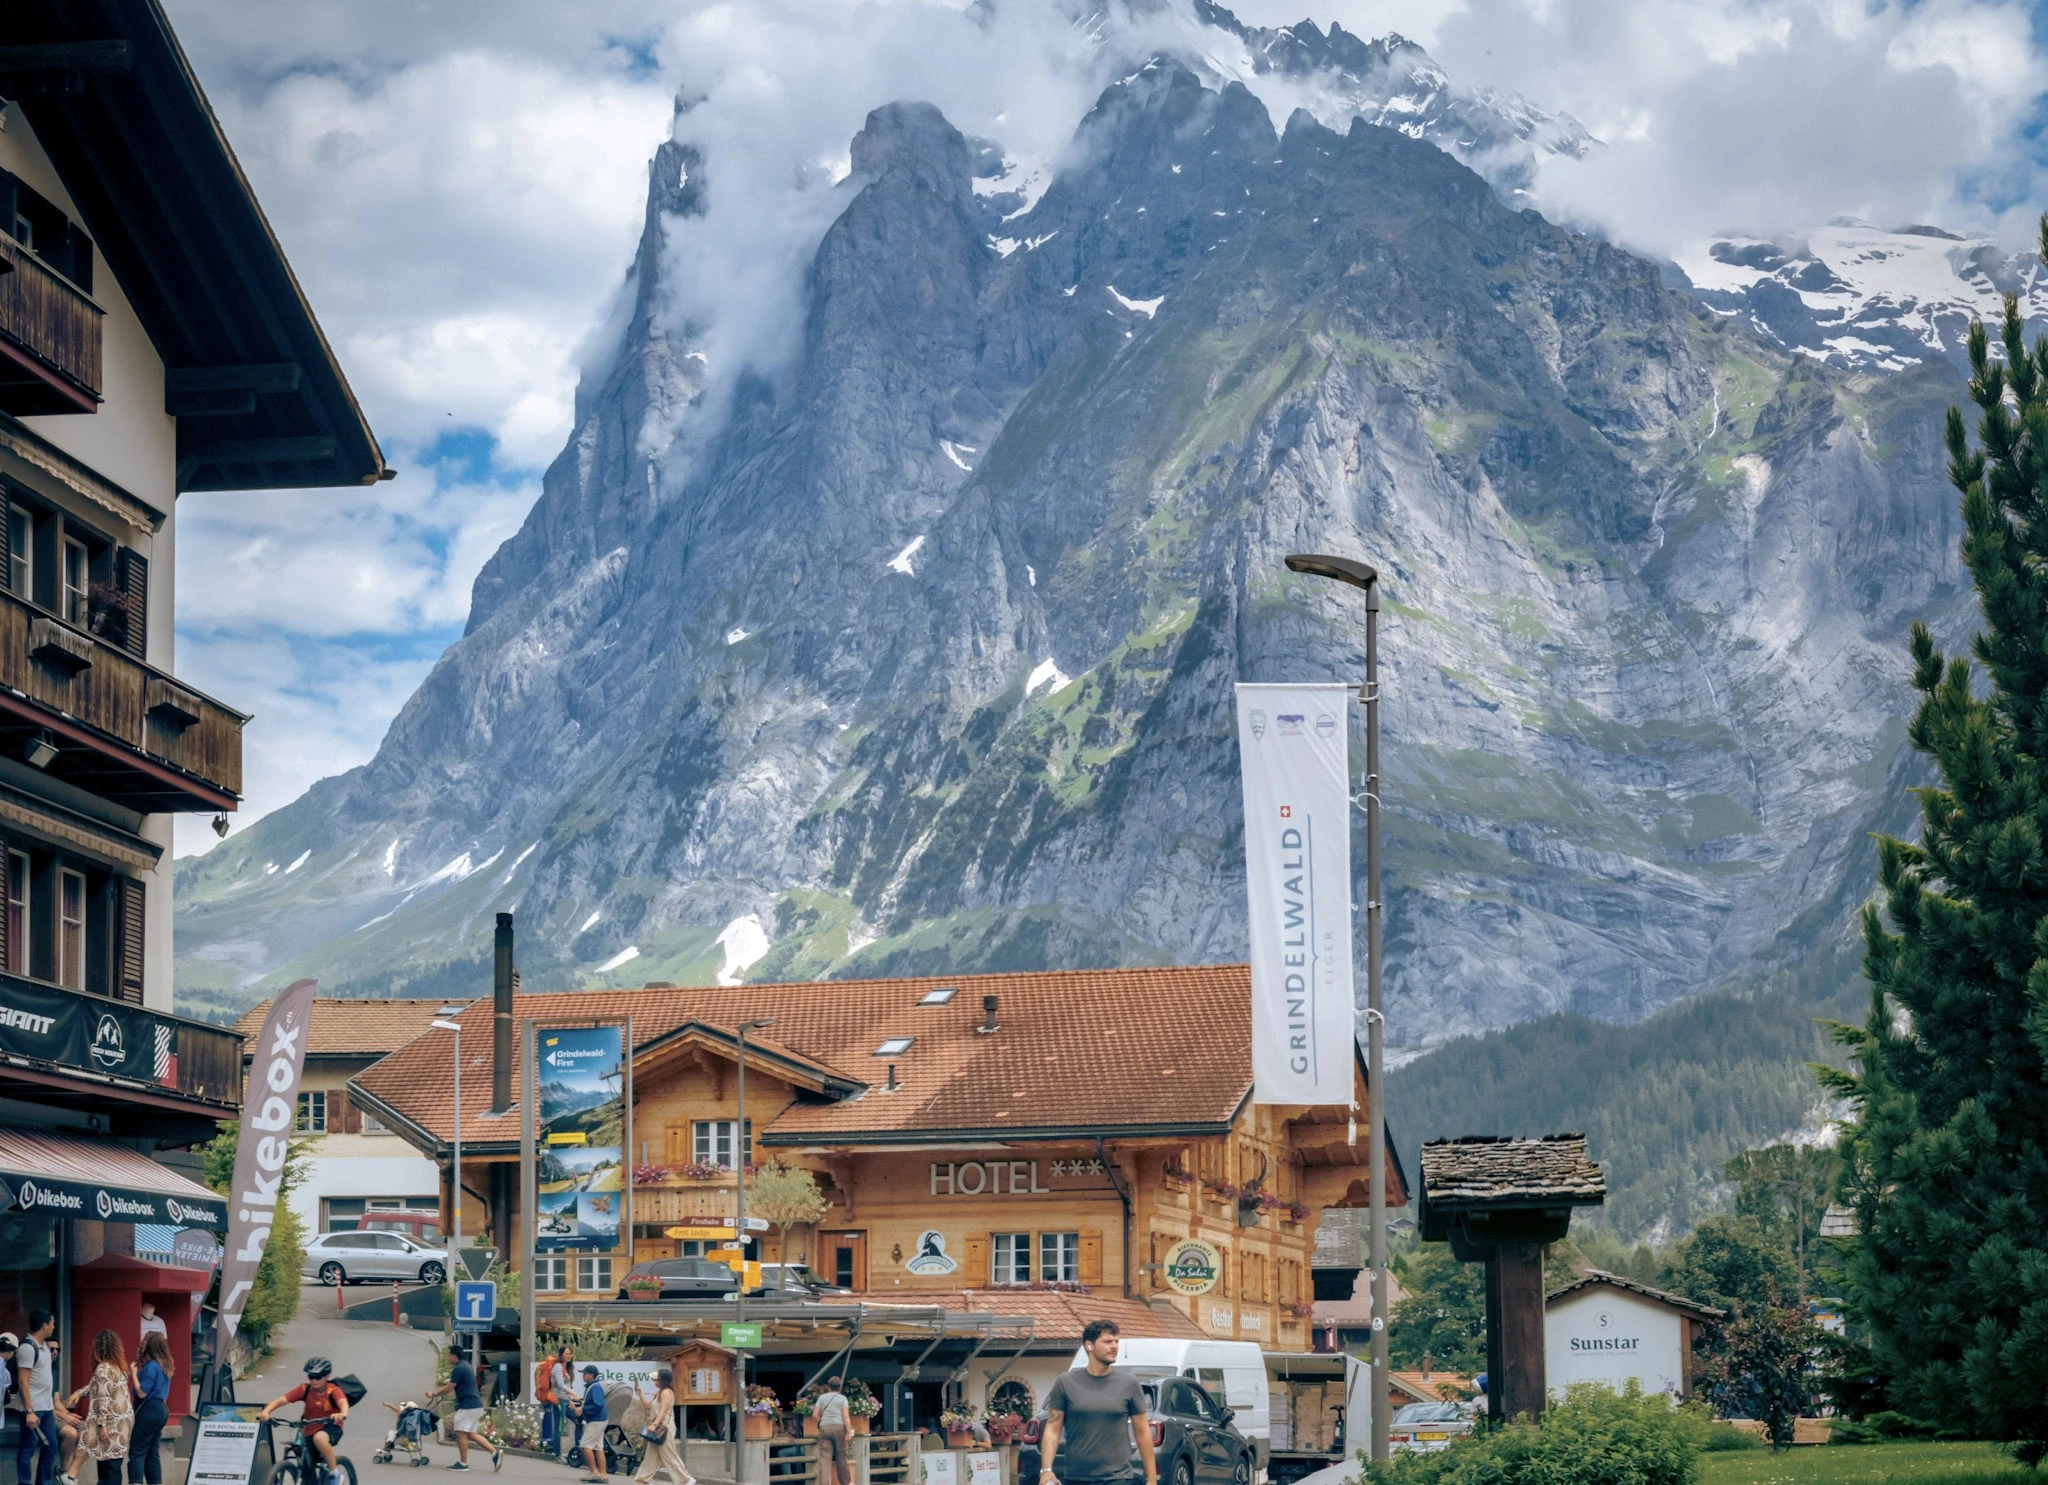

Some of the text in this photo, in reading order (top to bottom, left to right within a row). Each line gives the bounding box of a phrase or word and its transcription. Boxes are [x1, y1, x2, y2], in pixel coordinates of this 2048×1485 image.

[1281, 827, 1309, 1075] GRINDELWALD
[1323, 931, 1334, 985] EIGER
[0, 1006, 56, 1035] GIANT
[557, 1059, 574, 1067] First
[930, 1160, 1050, 1196] HOTEL
[691, 1218, 719, 1226] Firstbahn
[674, 1229, 710, 1238] First Lodge
[1177, 1243, 1212, 1257] RISTORANTE
[1175, 1267, 1207, 1278] Da Salvi
[1173, 1279, 1208, 1292] PIZZERIA
[1600, 1315, 1608, 1327] S
[1570, 1337, 1640, 1351] Sunstar
[598, 1369, 624, 1382] ake
